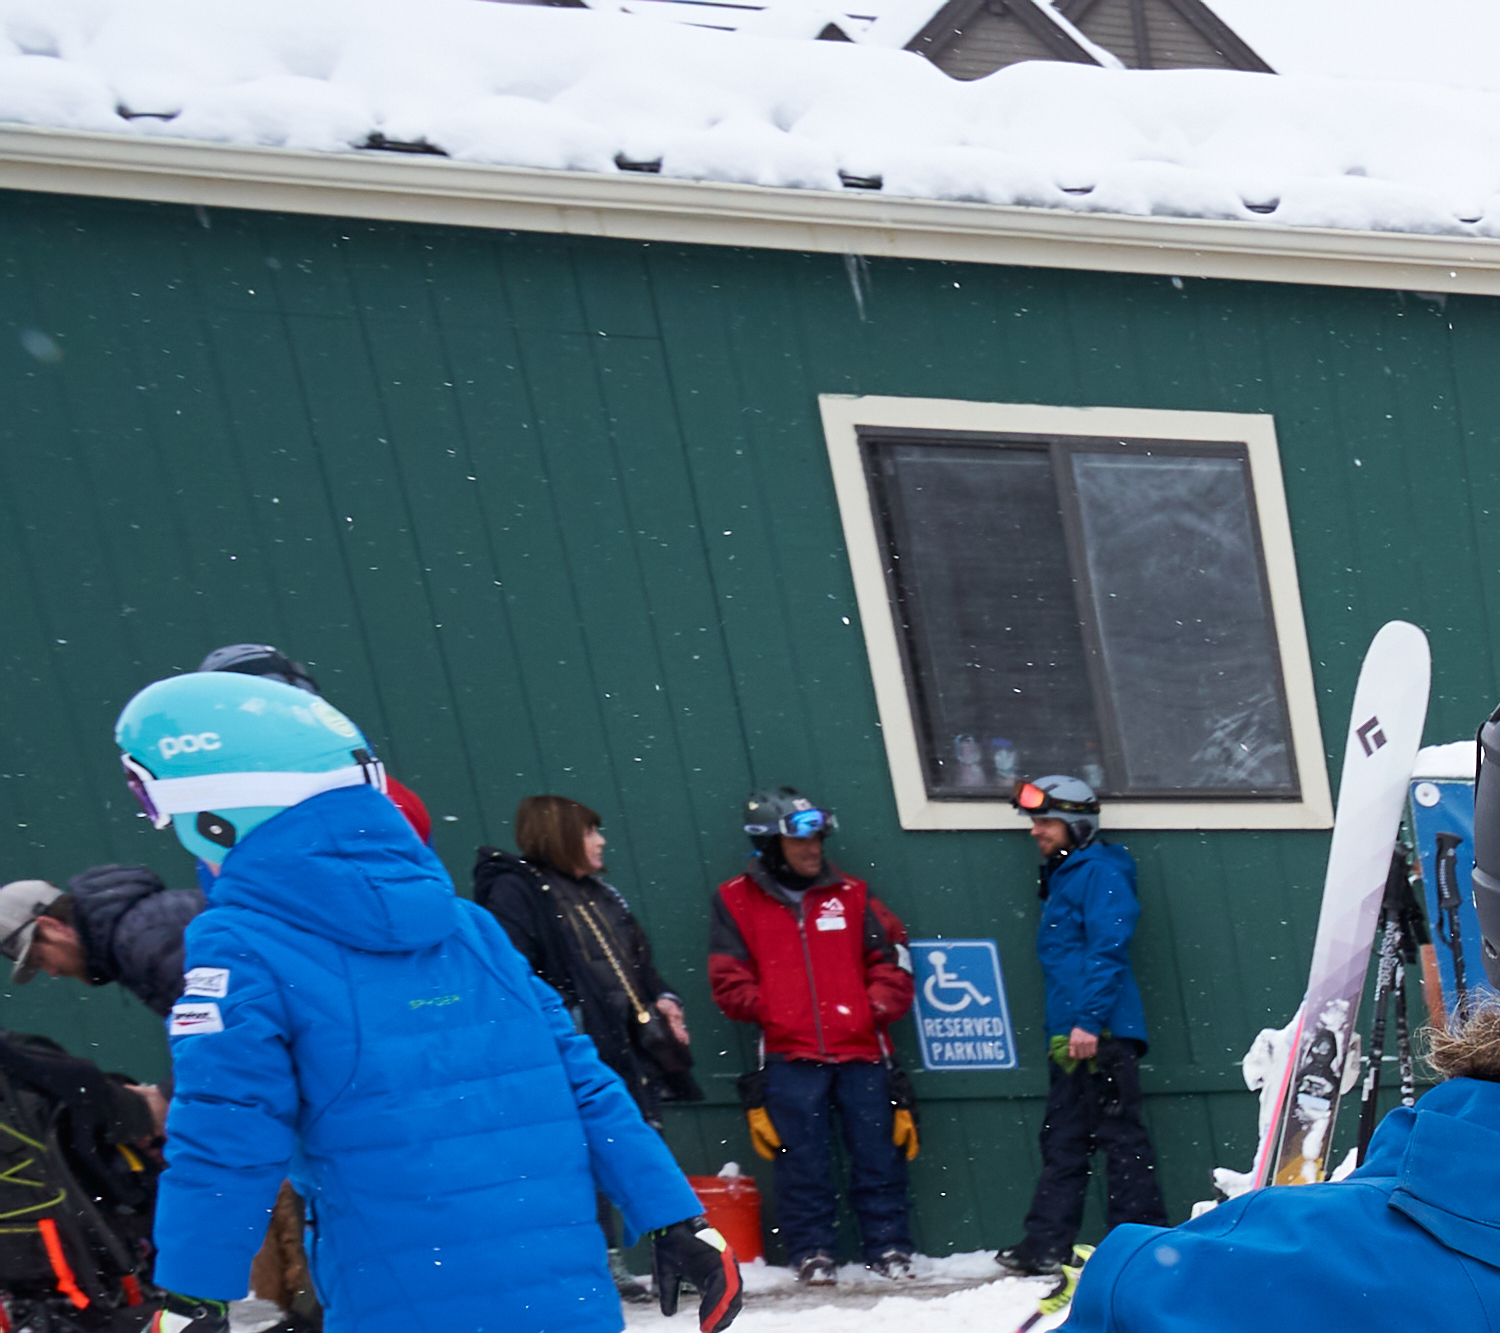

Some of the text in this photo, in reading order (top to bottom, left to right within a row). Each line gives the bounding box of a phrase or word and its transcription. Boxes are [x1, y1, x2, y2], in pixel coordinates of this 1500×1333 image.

[158, 732, 222, 759] poc
[923, 1017, 1006, 1038] RESERVED
[931, 1040, 1006, 1061] PARKING
